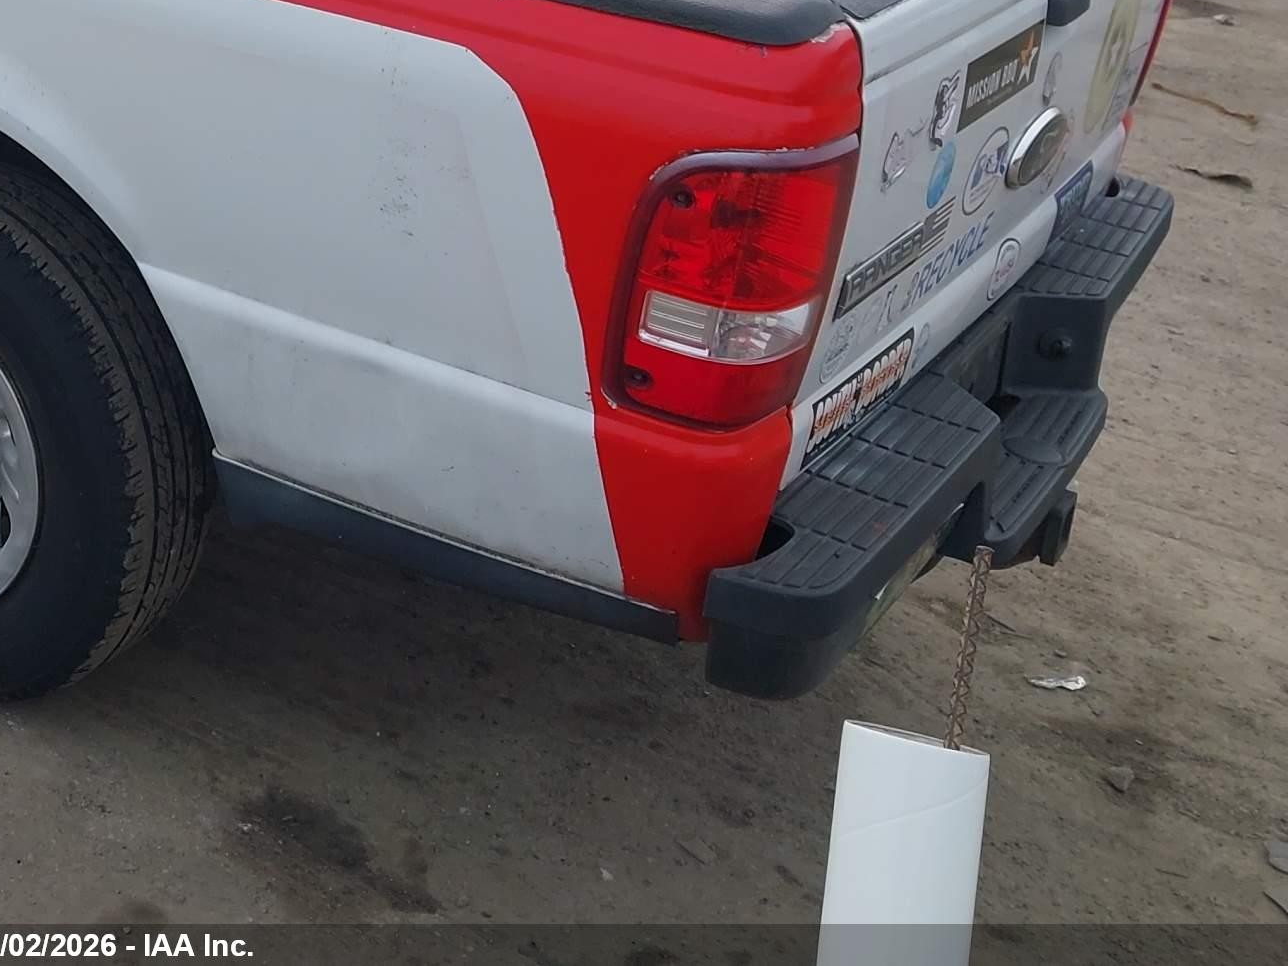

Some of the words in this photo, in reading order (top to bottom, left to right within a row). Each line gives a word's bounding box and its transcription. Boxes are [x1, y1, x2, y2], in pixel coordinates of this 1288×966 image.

[966, 68, 1002, 110] MISSION
[1000, 58, 1021, 88] BBQ
[850, 227, 925, 299] RANGER
